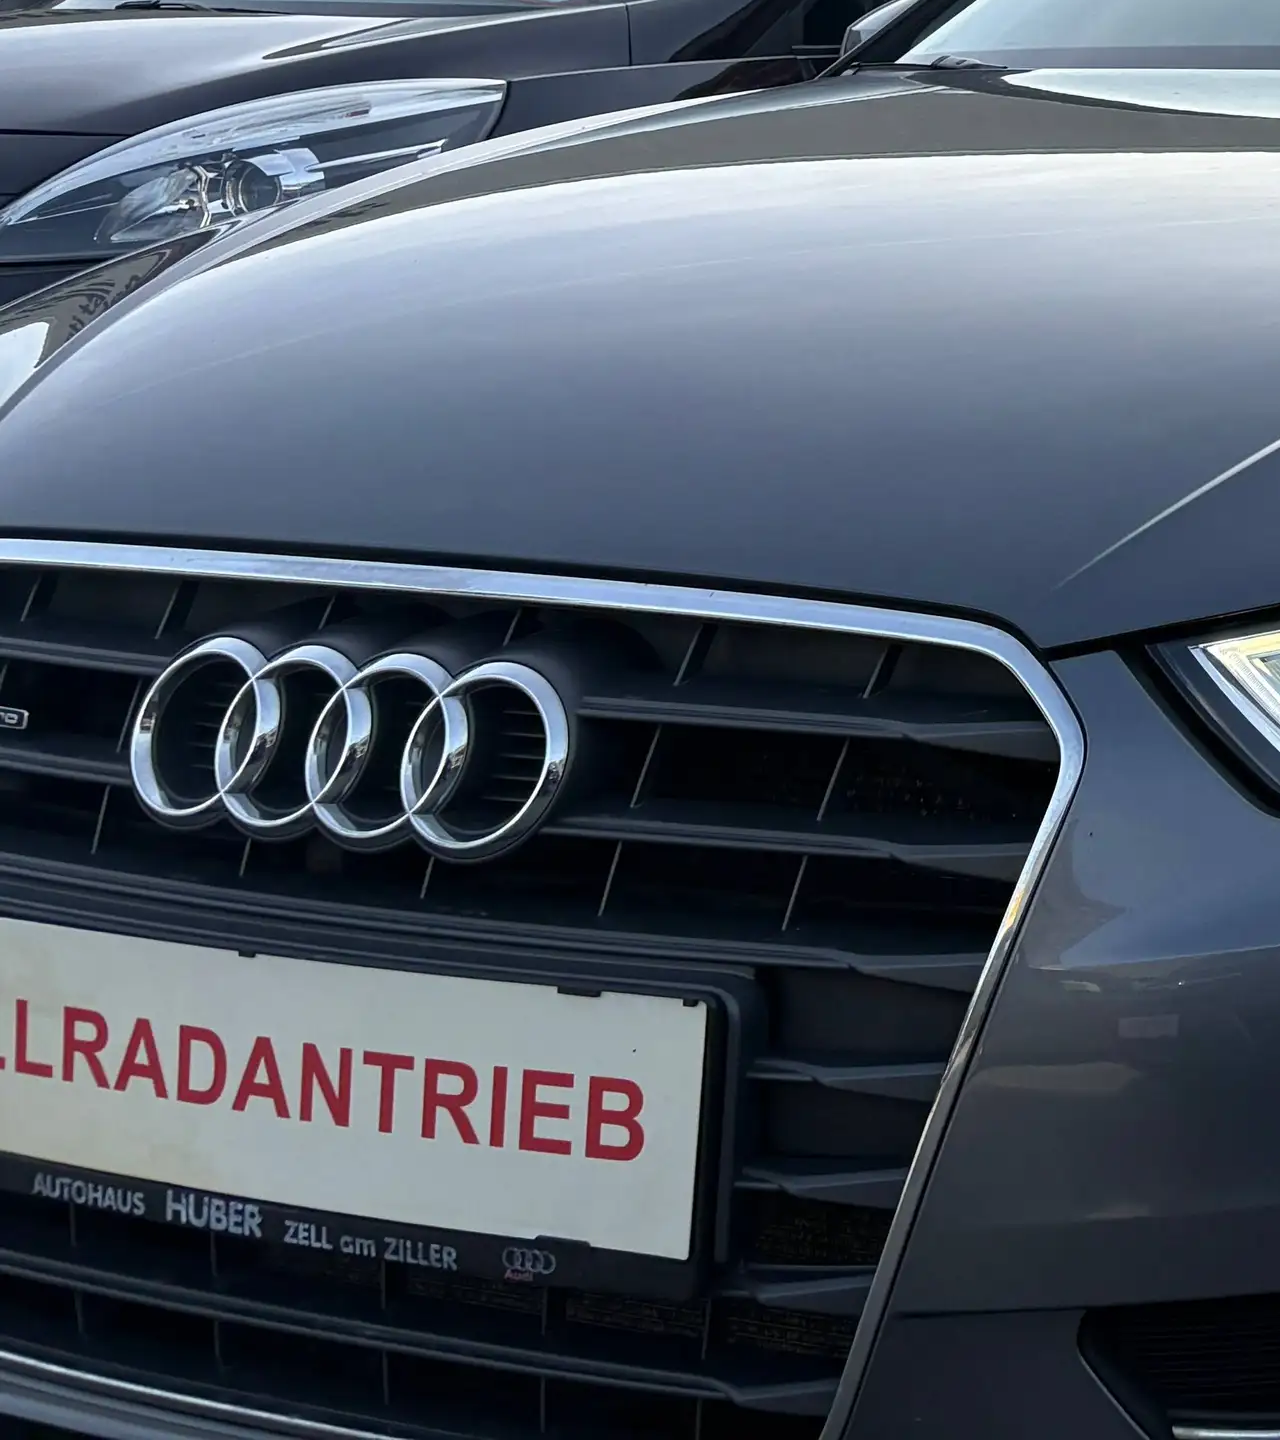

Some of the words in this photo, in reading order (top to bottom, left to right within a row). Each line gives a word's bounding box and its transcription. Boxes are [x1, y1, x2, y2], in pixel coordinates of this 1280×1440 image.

[0, 999, 645, 1163] LRADANTRIEB
[32, 1171, 146, 1216] AUTOHAUS
[165, 1189, 264, 1239] HUBER
[283, 1219, 334, 1251] ZELL
[383, 1236, 458, 1271] ZILLER
